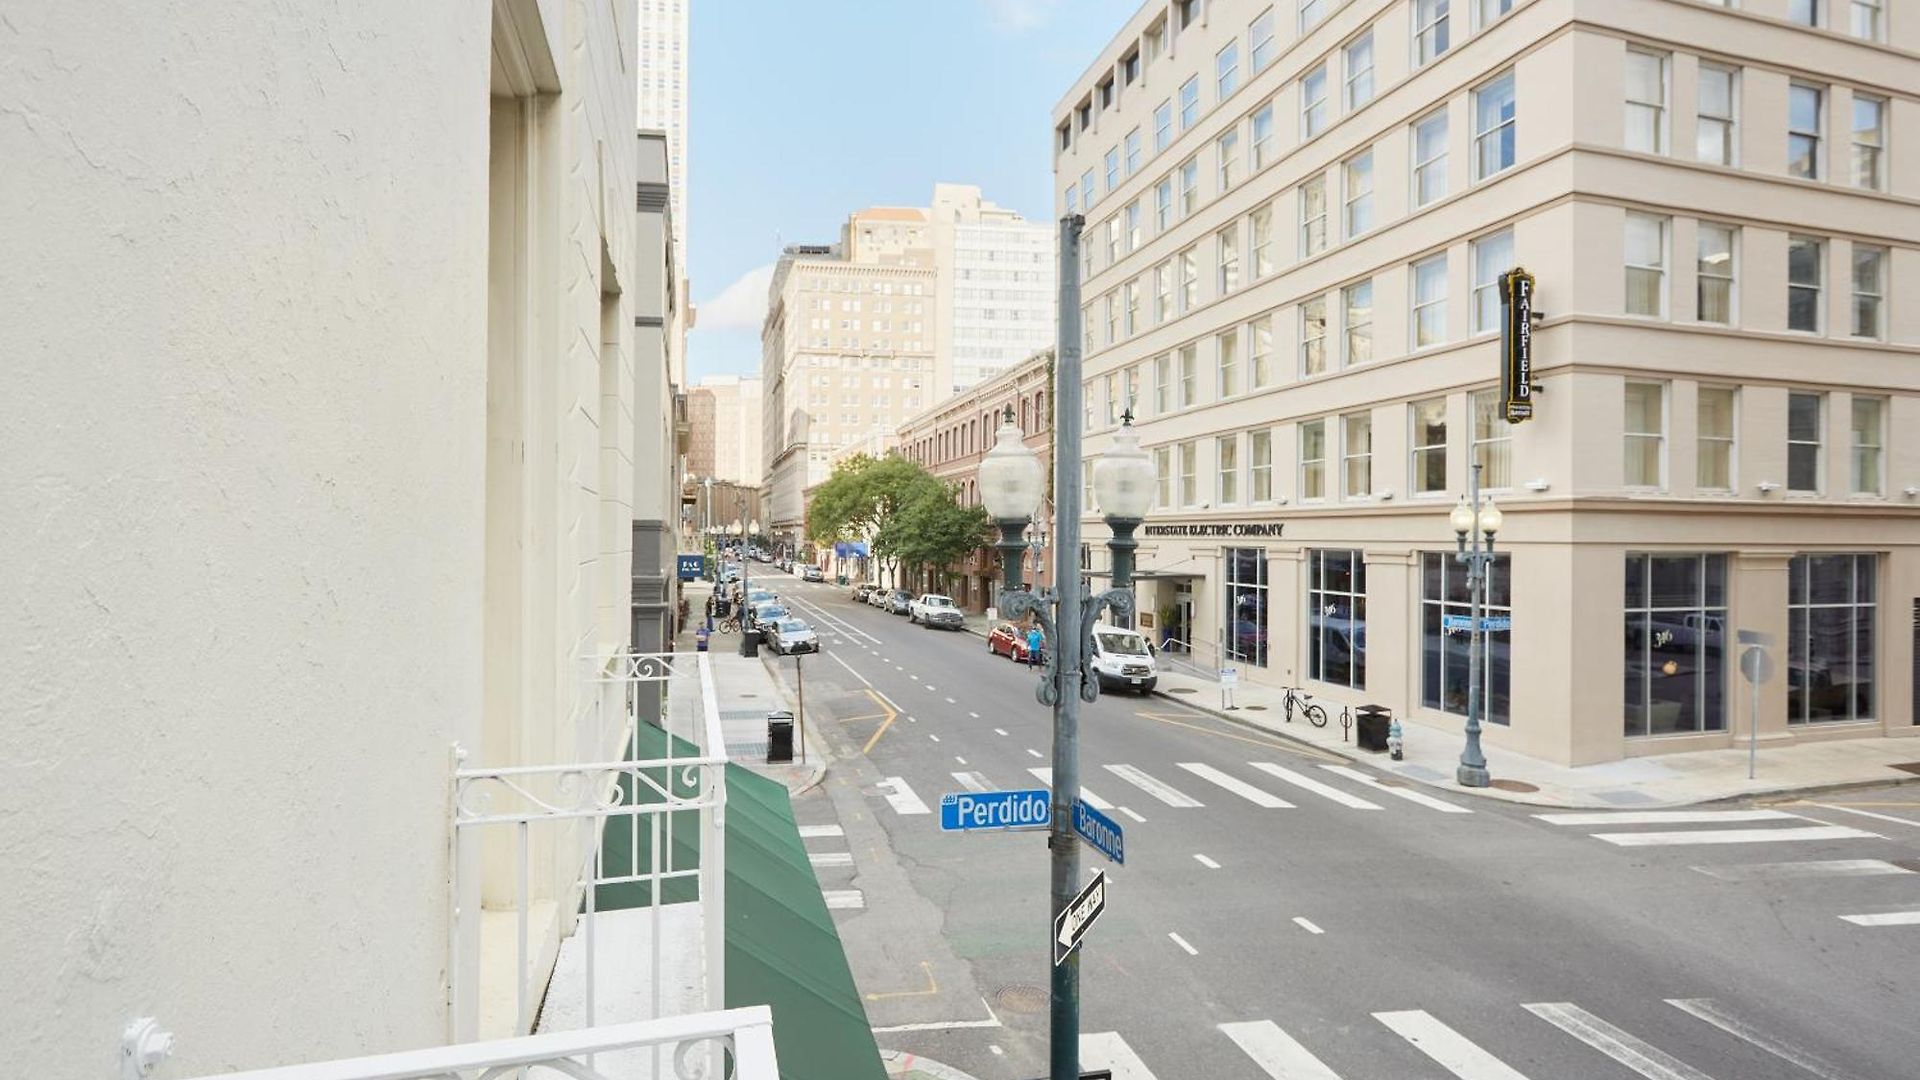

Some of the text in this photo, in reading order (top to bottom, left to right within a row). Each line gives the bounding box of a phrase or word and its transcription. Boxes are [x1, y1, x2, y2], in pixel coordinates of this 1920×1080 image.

[1520, 280, 1529, 397] FAIRFIELD
[1145, 523, 1284, 536] INTERSTATE ELECTRIC COMPANY
[958, 794, 1047, 826] Perdido
[1079, 802, 1122, 859] Baronne
[1072, 889, 1101, 931] ONE WAY
